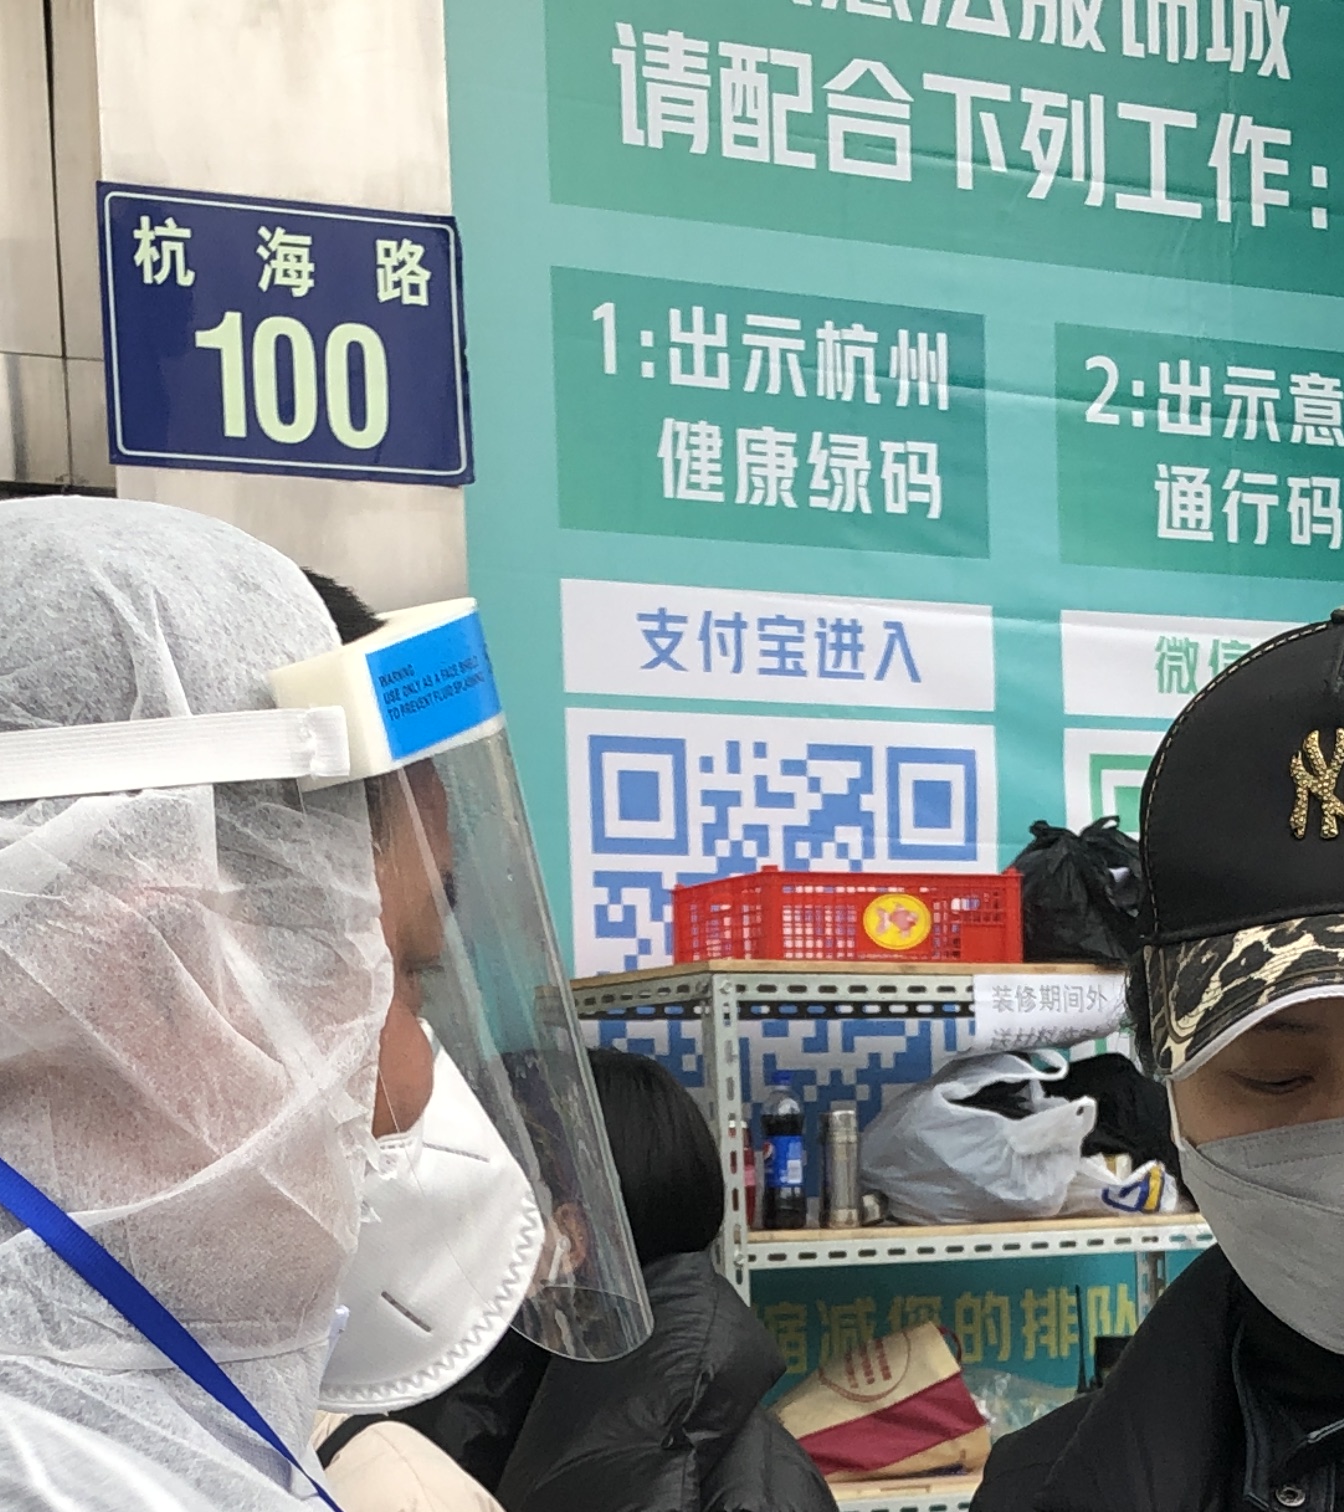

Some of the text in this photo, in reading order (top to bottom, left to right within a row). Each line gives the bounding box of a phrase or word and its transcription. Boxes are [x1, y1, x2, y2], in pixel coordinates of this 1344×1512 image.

[132, 214, 432, 307] 杭海路
[194, 310, 390, 450] 100
[591, 302, 951, 411] 1:出示杭州
[657, 416, 944, 521] 健康绿码
[1154, 462, 1344, 550] 通行码
[636, 607, 922, 683] 支付宝进入
[992, 984, 1108, 1014] 装修期间外
